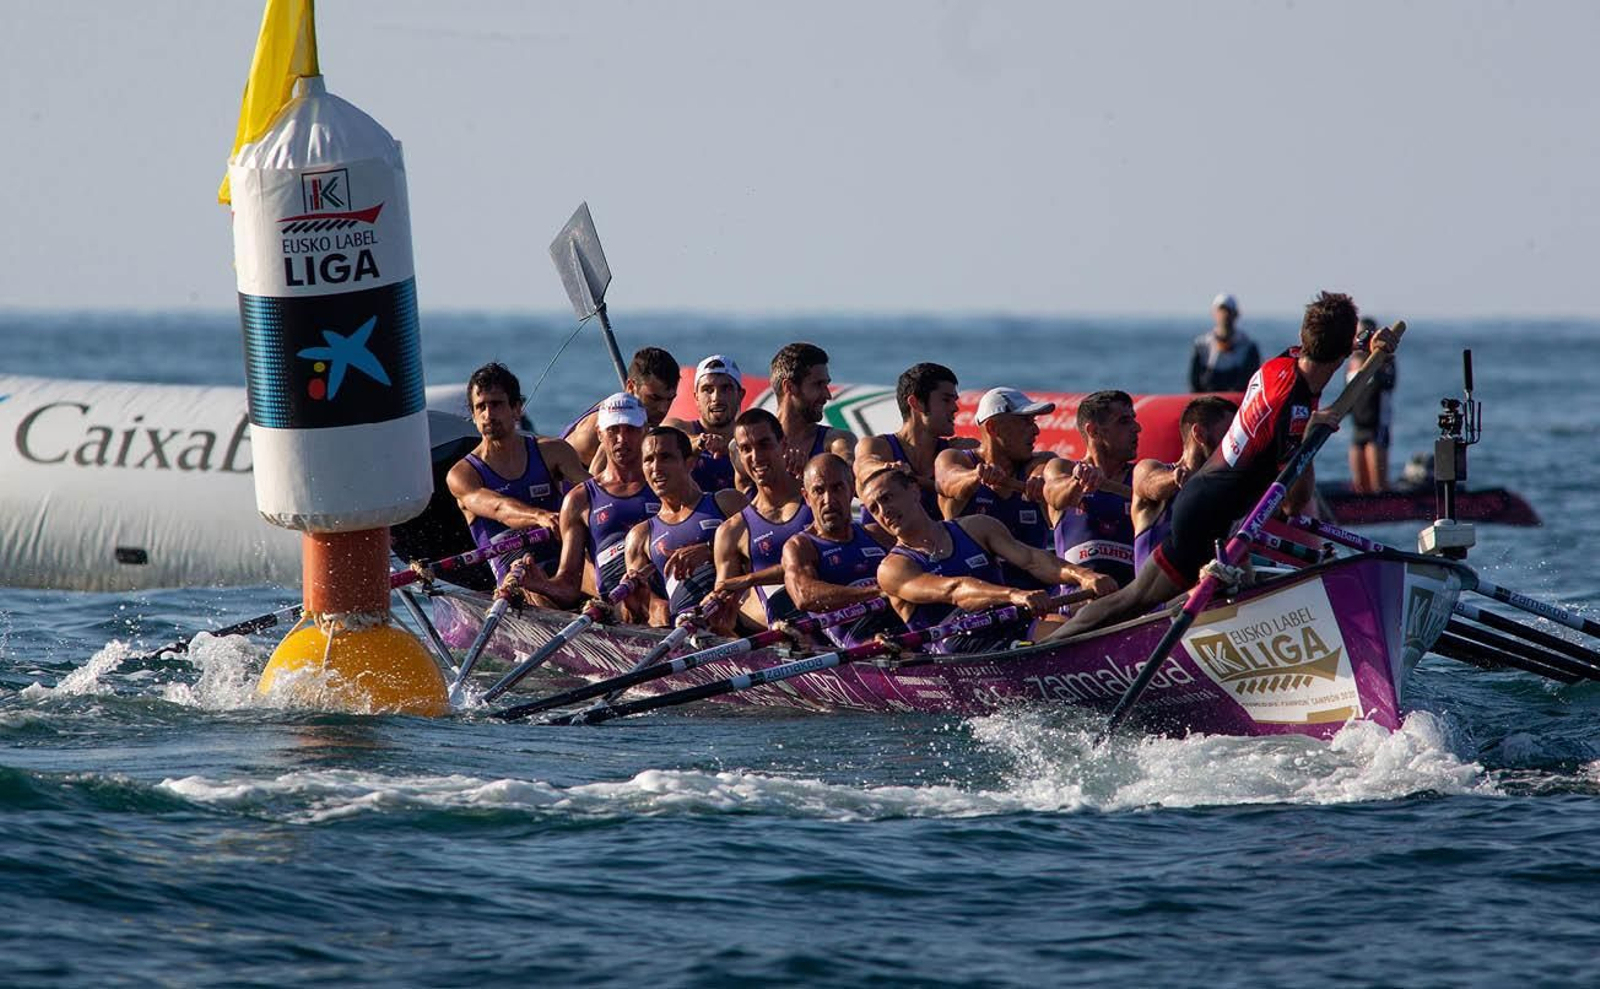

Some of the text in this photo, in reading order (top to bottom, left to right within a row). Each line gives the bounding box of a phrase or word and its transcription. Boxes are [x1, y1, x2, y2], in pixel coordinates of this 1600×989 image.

[282, 230, 378, 254] EUSKO LABEL
[284, 249, 381, 286] LIGA
[15, 401, 254, 473] CaixaB
[1230, 607, 1316, 645] EUSKO LABEL
[1239, 626, 1330, 670] LIGA
